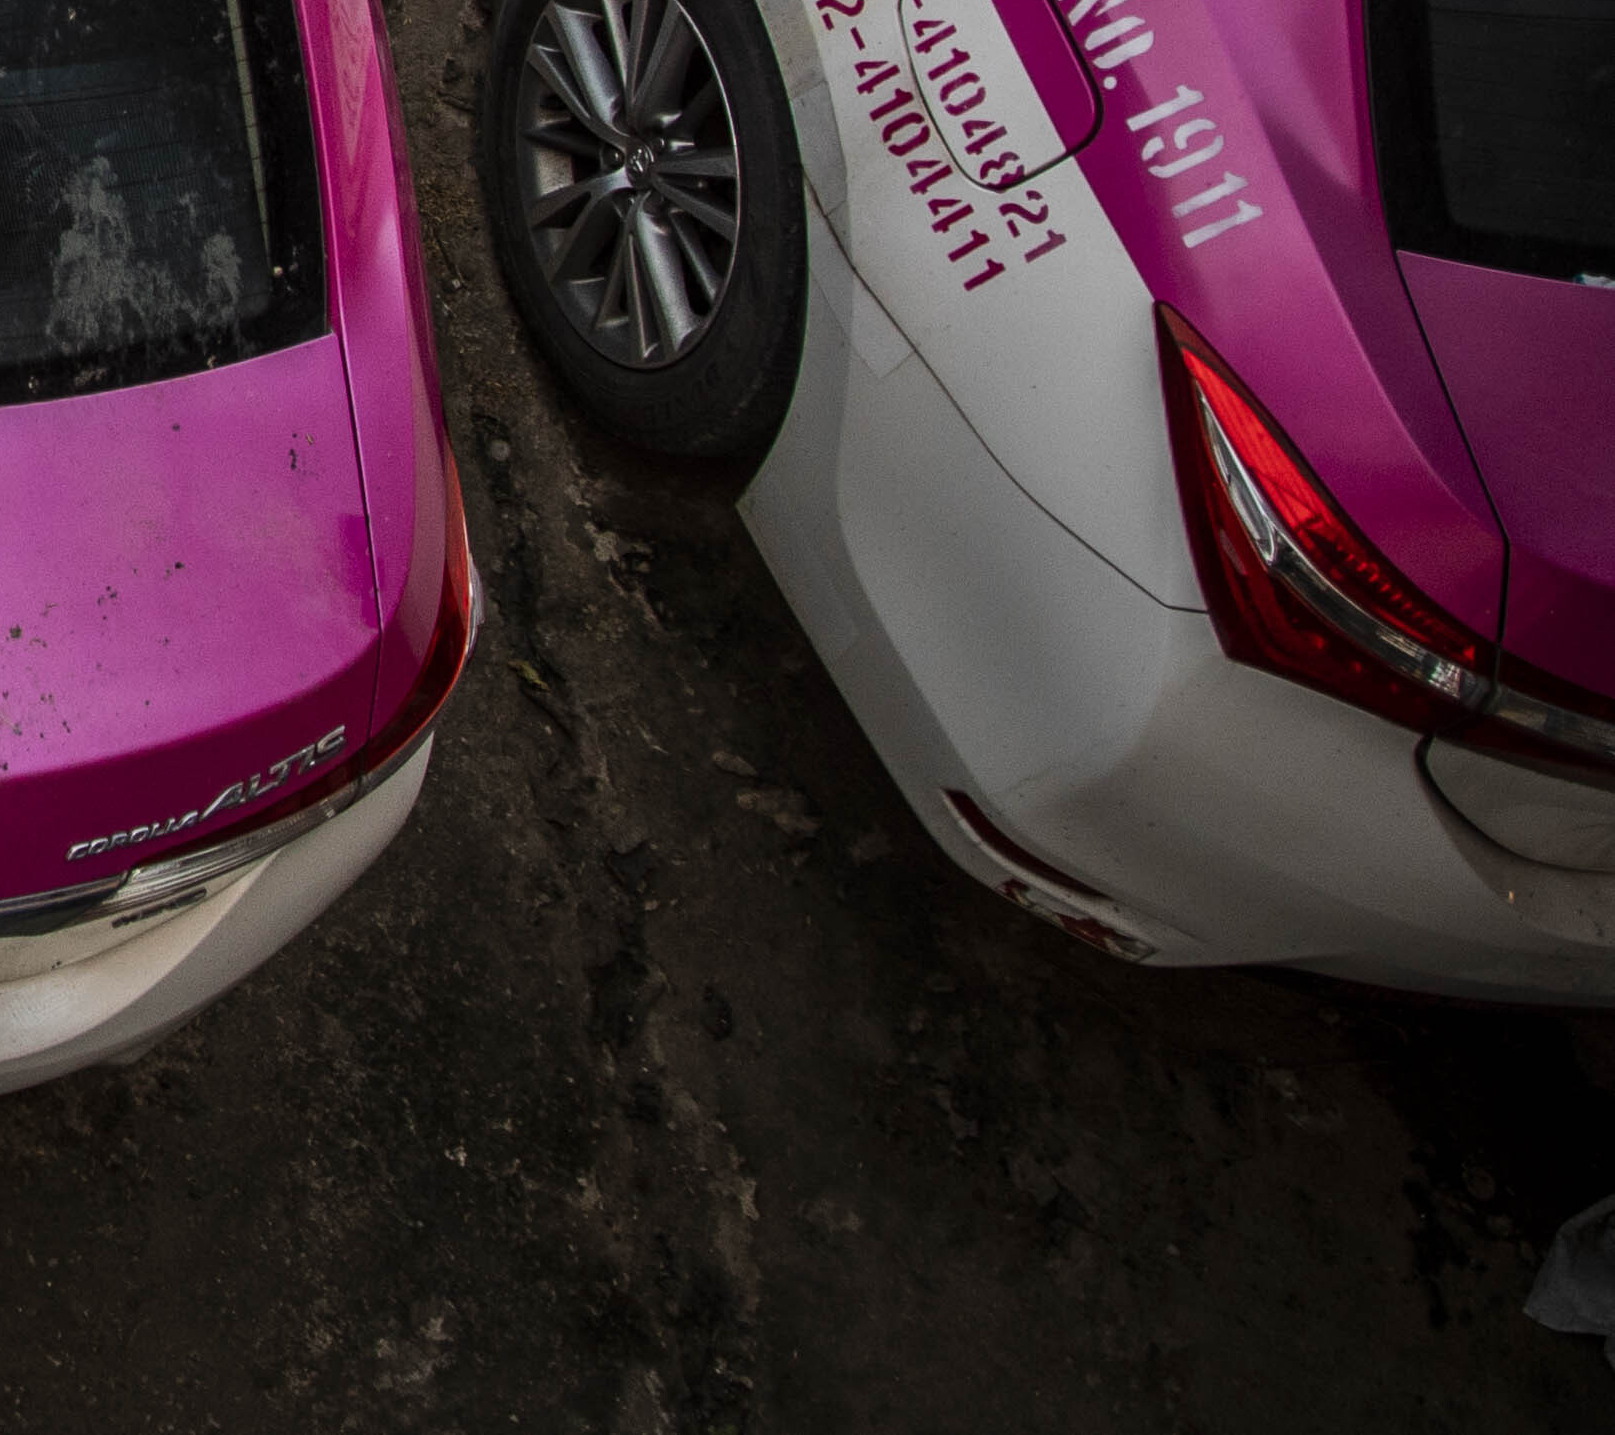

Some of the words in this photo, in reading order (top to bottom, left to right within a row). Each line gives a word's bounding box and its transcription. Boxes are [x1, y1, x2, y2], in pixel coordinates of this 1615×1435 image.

[1126, 83, 1264, 249] 1911
[65, 810, 199, 861] COROLLA
[200, 724, 346, 820] ALTIS
